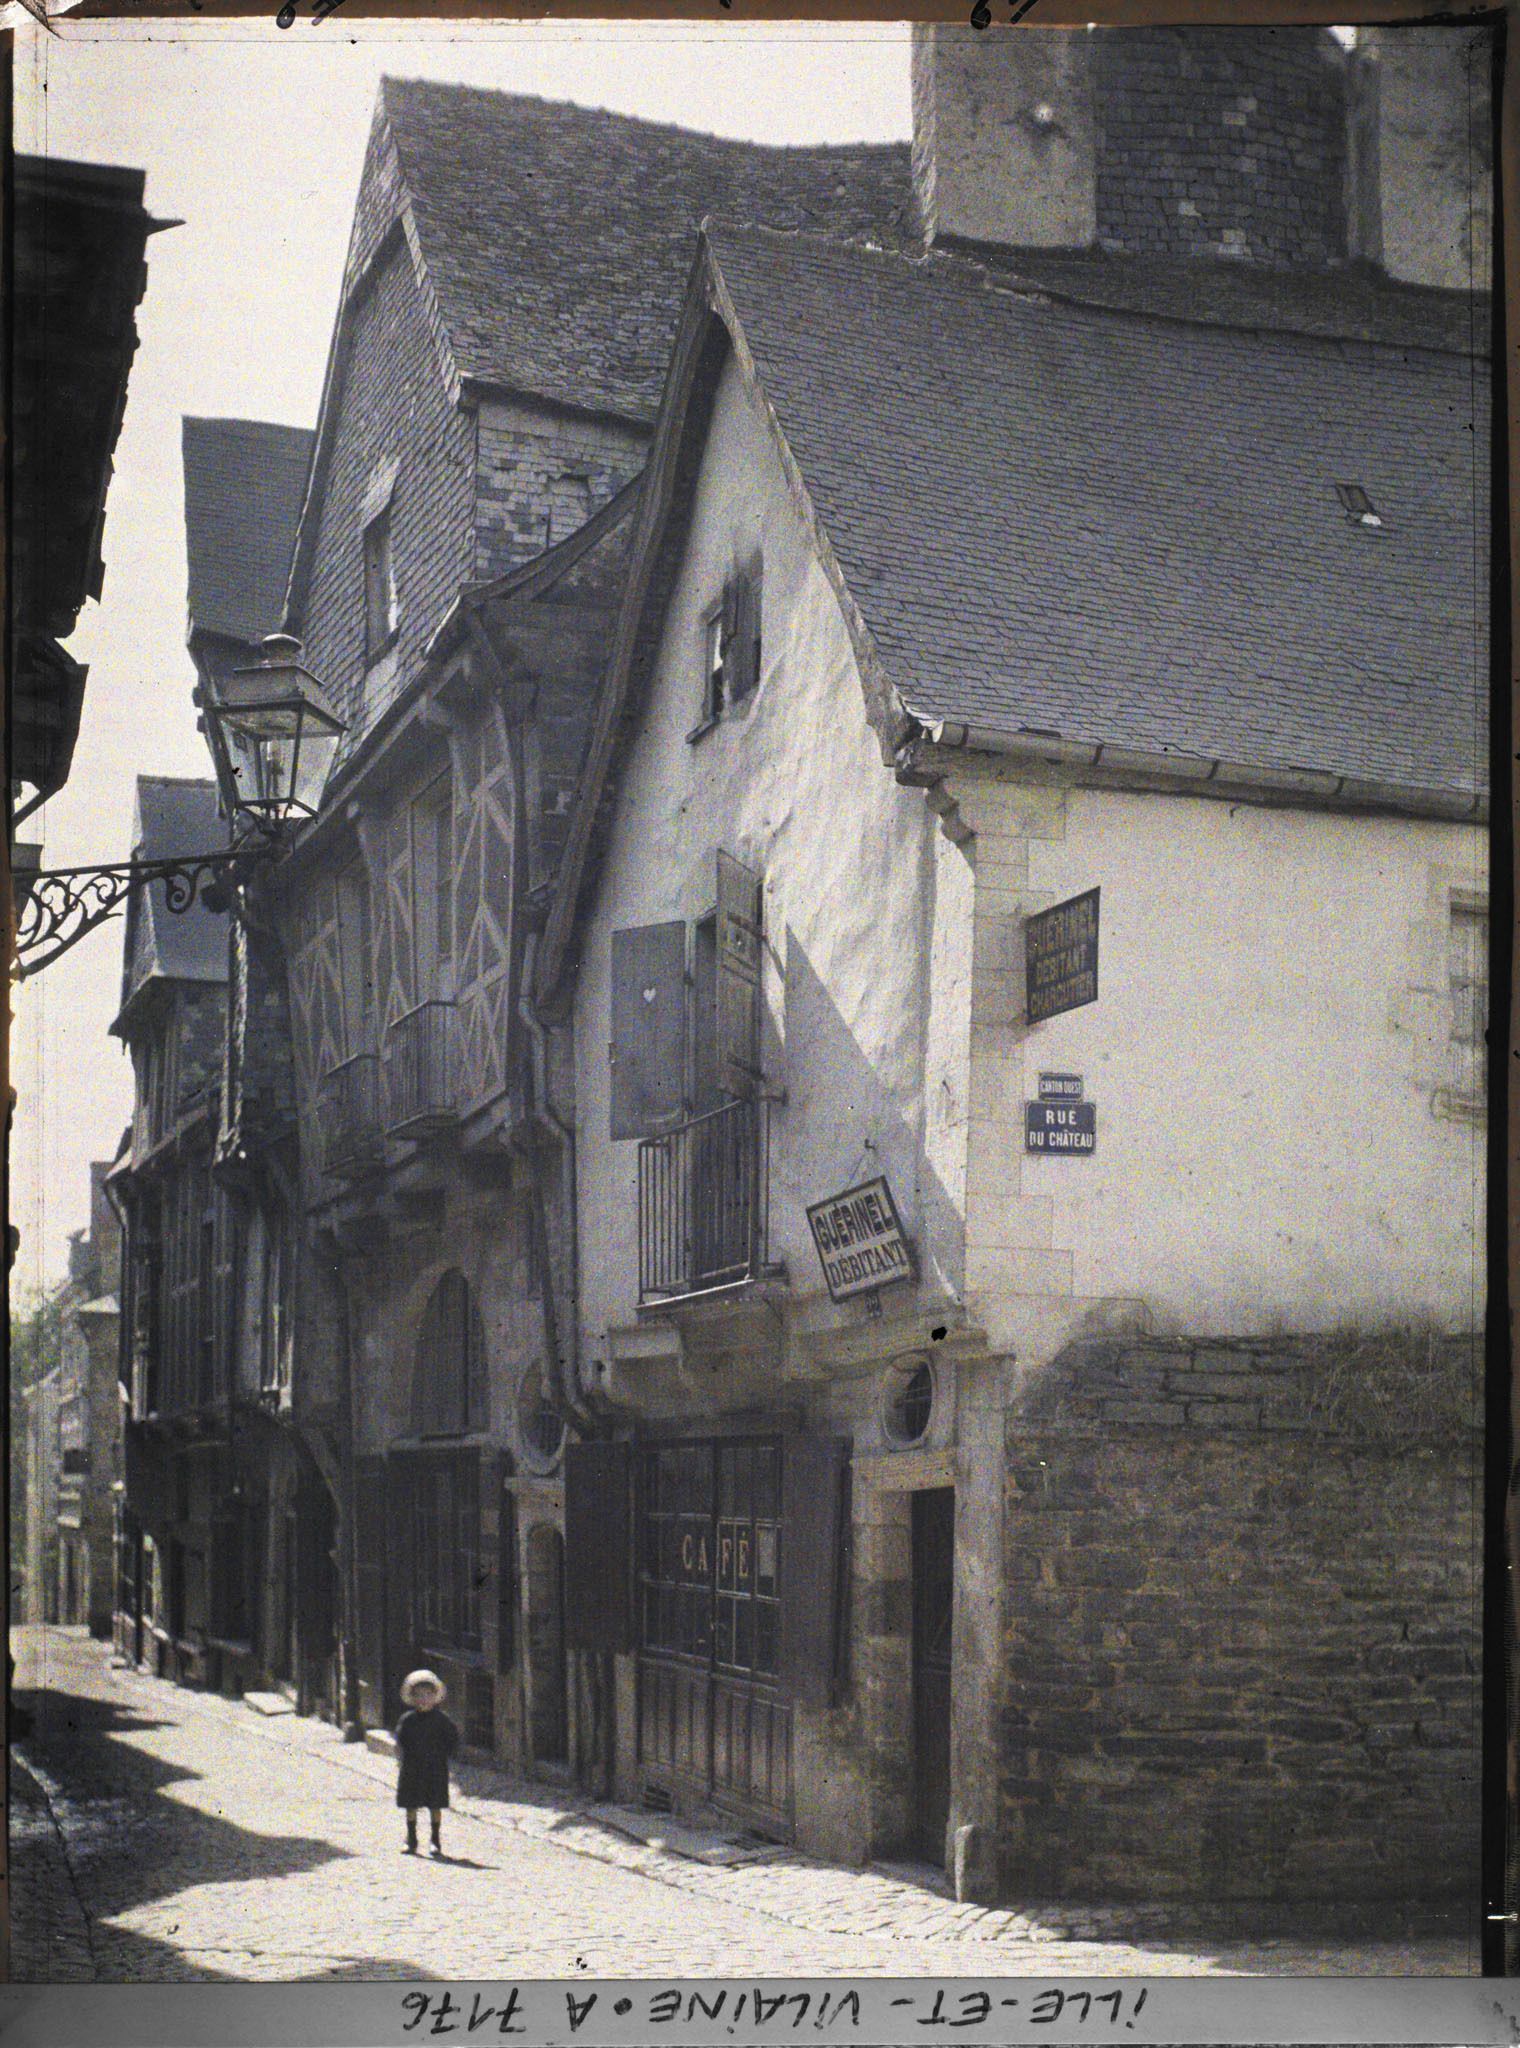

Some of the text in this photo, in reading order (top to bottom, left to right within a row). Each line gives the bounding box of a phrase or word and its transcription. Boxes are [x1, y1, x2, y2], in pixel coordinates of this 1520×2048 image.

[1029, 1129, 1093, 1148] DU CHÂTEAU
[1046, 1110, 1077, 1125] RUE
[815, 1192, 898, 1254] GUÉRINEL
[828, 1239, 907, 1288] DÉBITANT
[682, 1531, 749, 1578] CAFÉ
